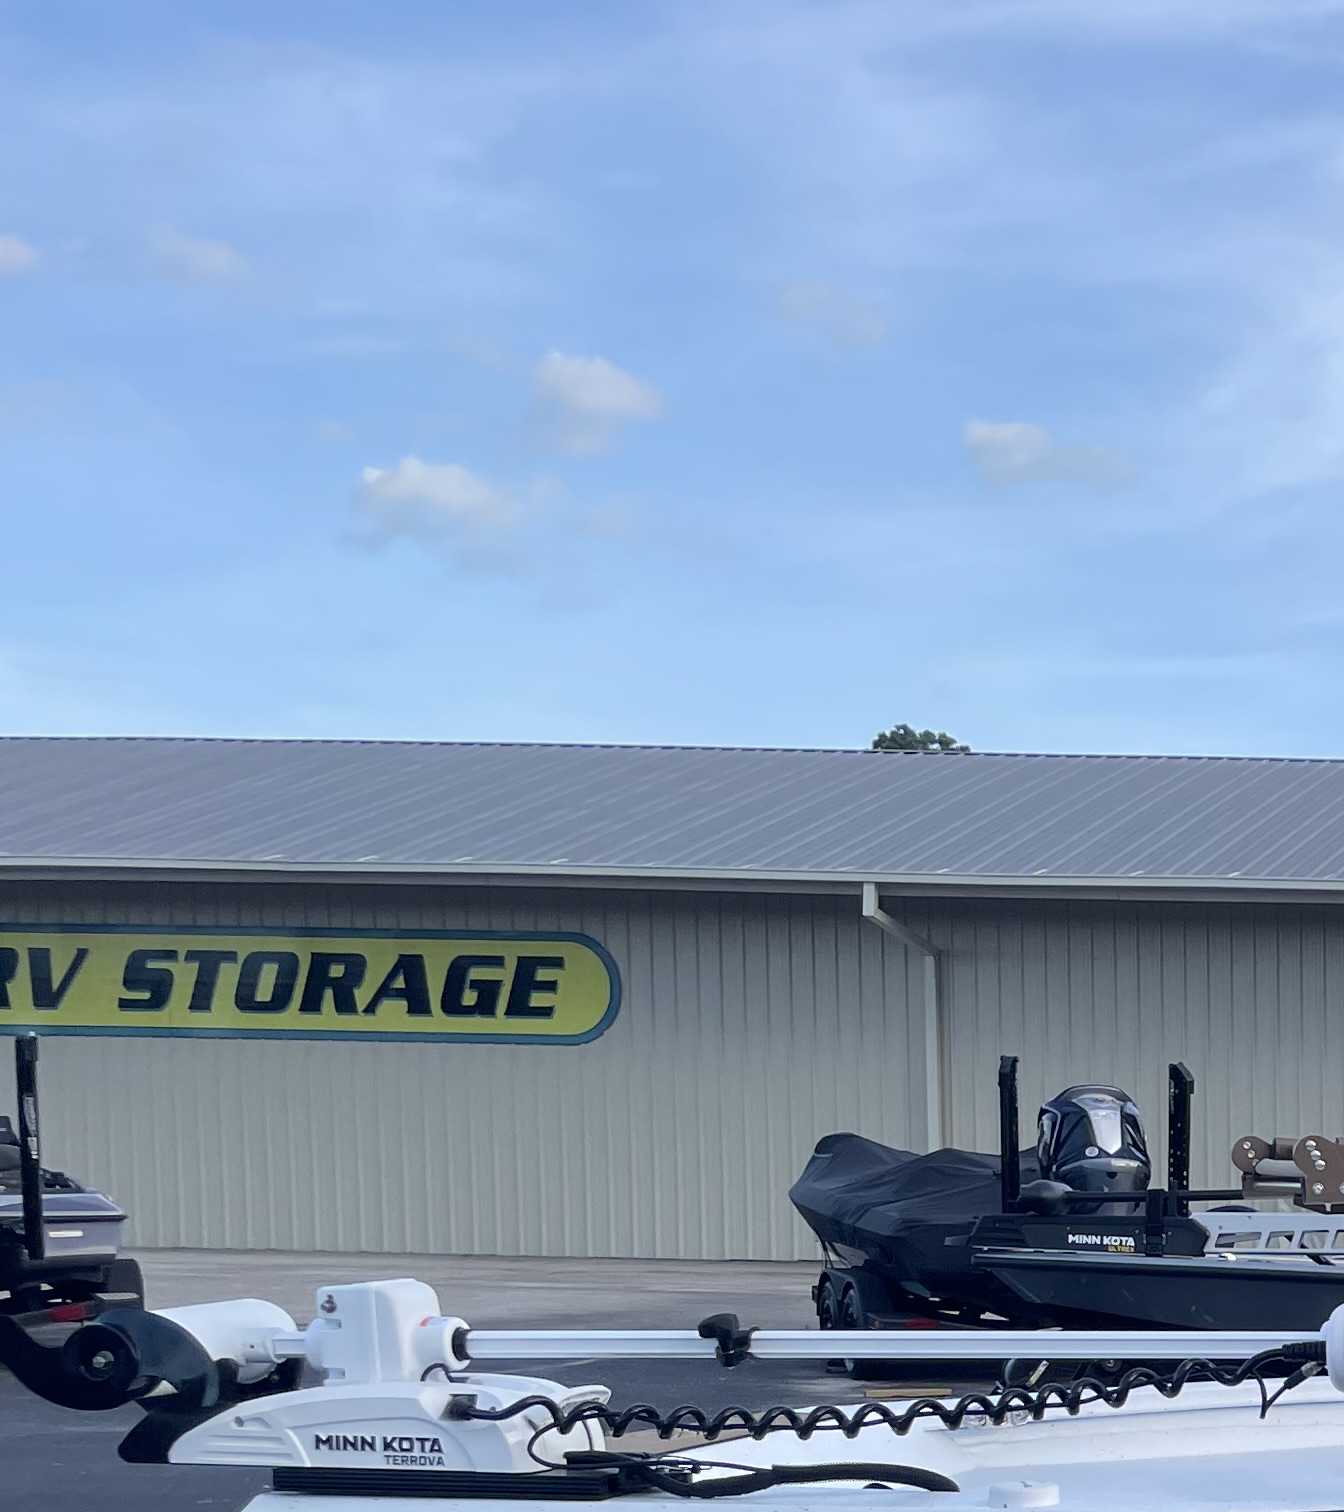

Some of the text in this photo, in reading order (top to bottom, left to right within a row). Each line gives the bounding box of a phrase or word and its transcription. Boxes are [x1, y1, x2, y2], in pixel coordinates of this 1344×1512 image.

[117, 949, 566, 1020] STORAGE
[1067, 1233, 1136, 1247] MINN KOTA
[314, 1433, 445, 1454] MINN KOTA
[383, 1454, 446, 1466] TERROVA
